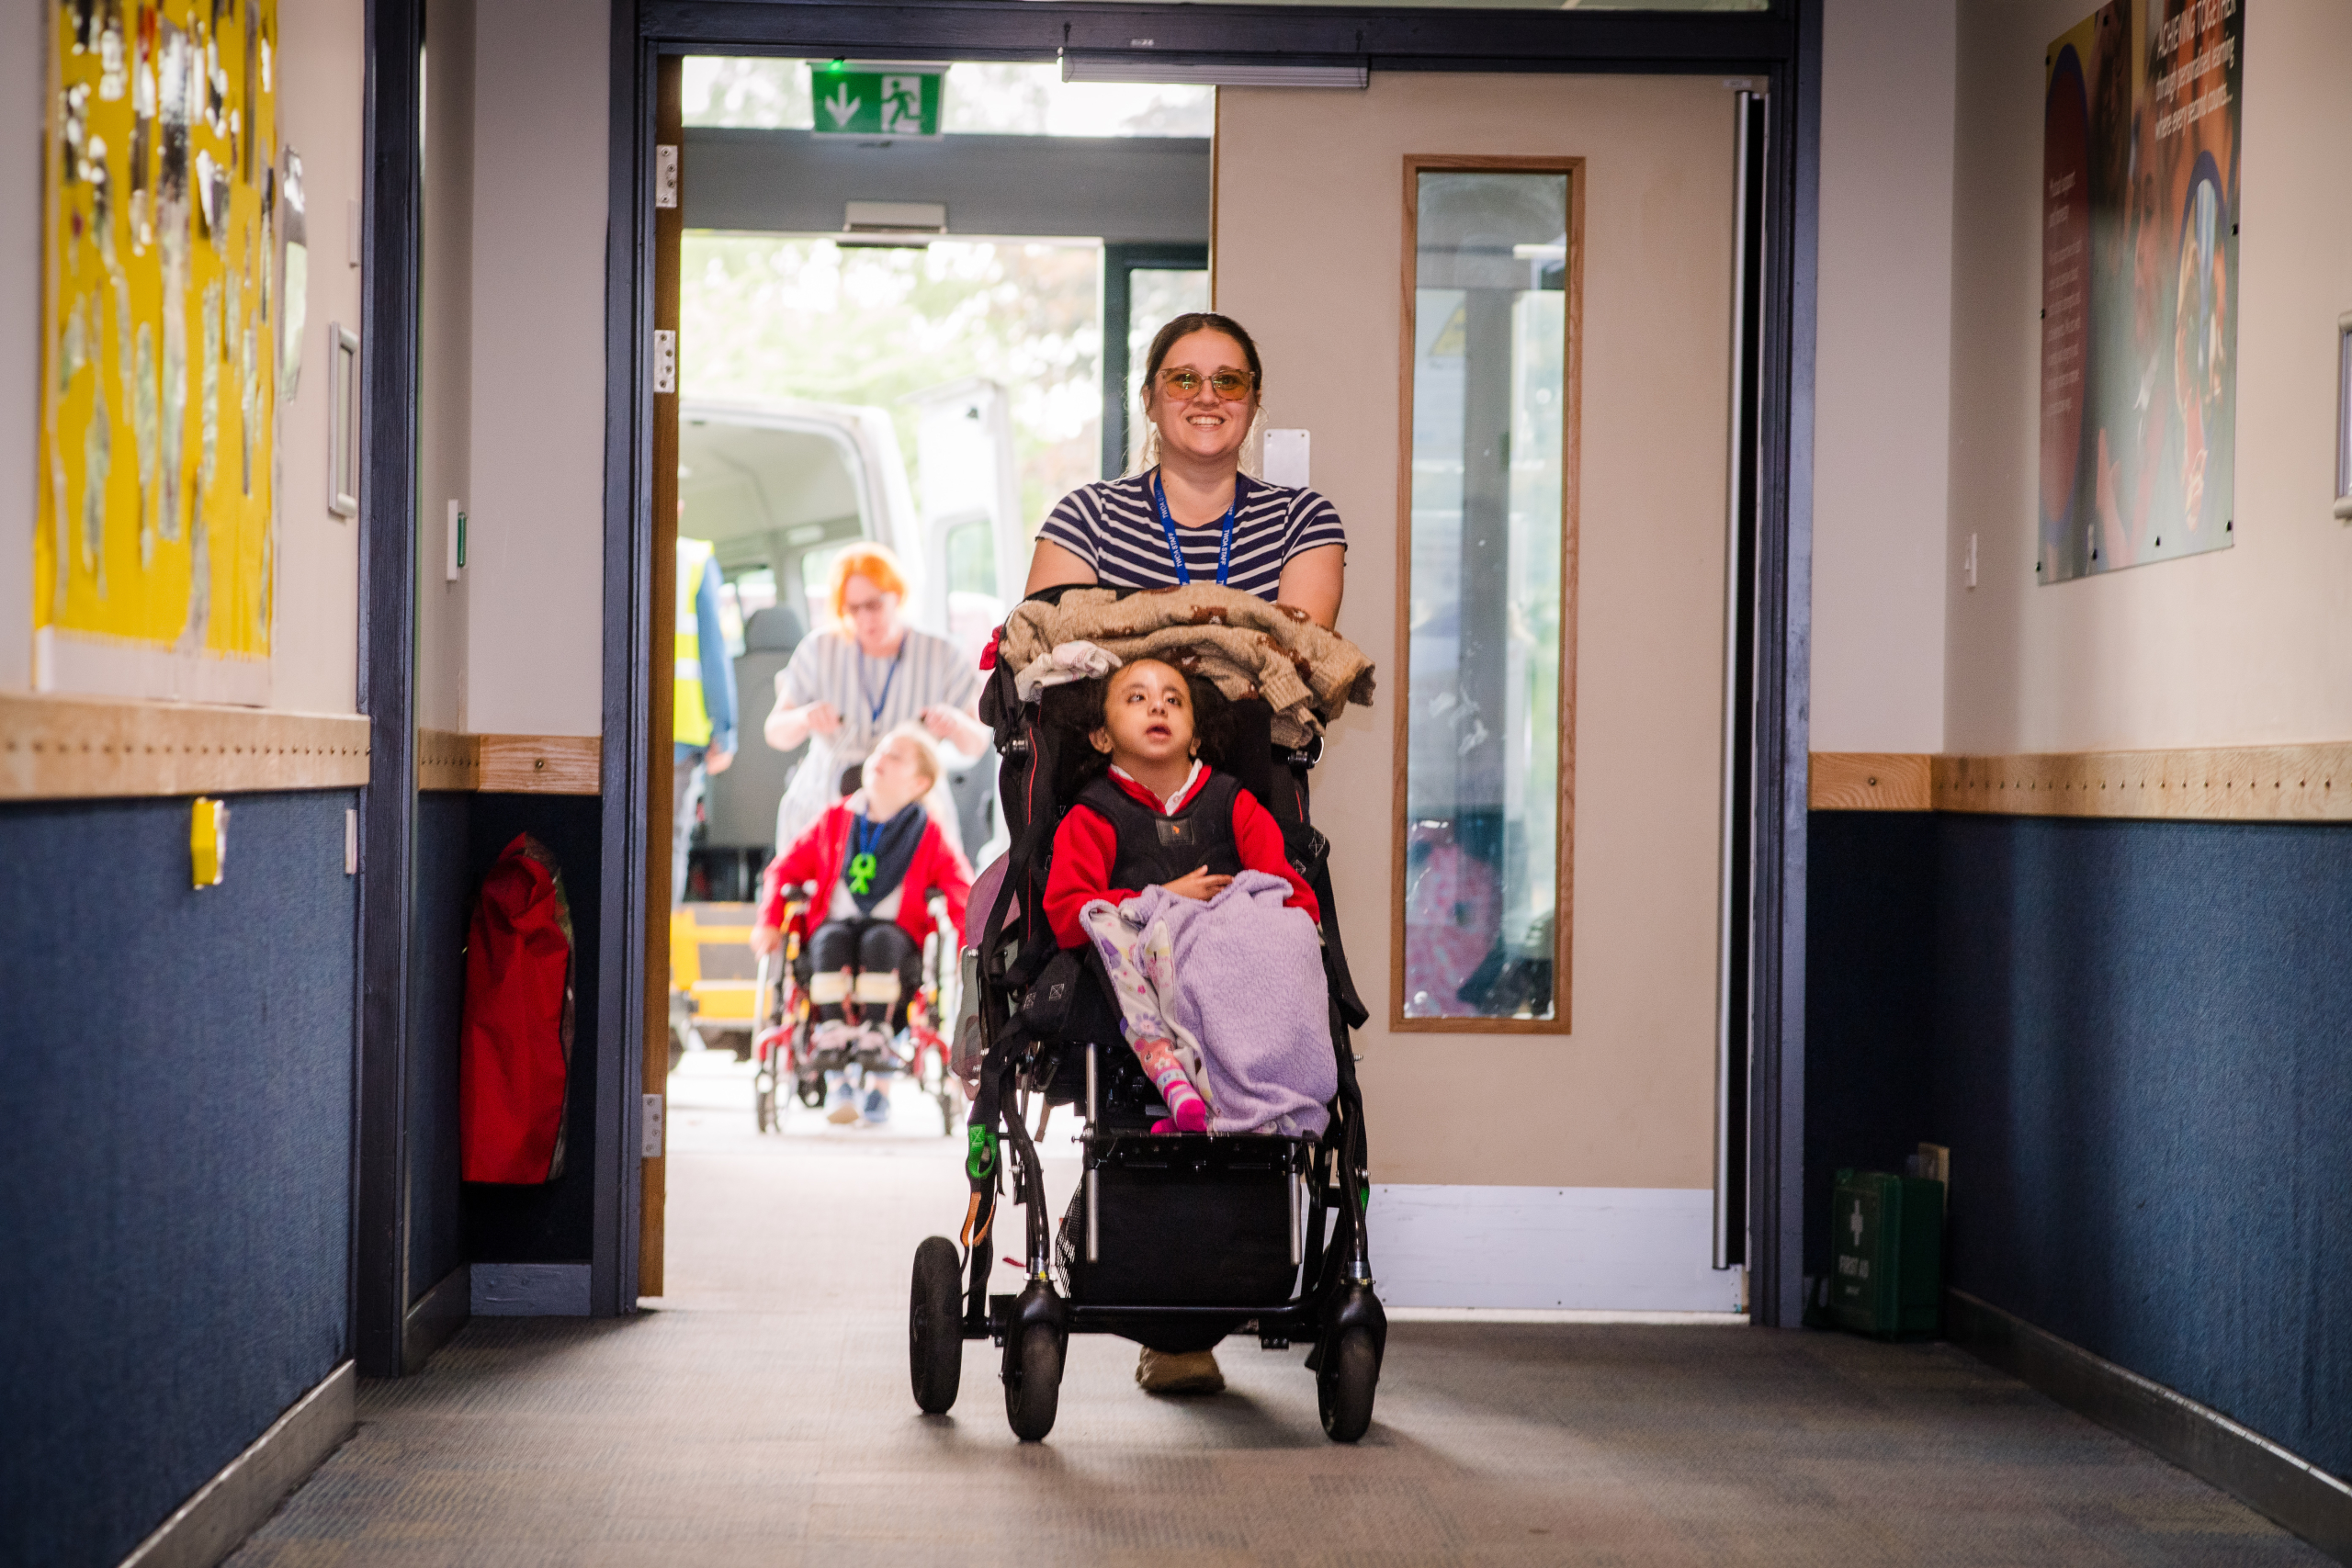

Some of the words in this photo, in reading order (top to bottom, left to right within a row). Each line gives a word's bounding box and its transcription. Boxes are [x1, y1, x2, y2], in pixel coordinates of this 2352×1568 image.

[2156, 4, 2195, 61] ACHIEVING
[2155, 62, 2177, 103] through
[2211, 32, 2234, 70] learning
[2155, 109, 2173, 141] where
[2172, 106, 2188, 137] every
[2187, 84, 2207, 125] second
[1168, 532, 1178, 549] STAFF
[1221, 529, 1229, 547] TWOA
